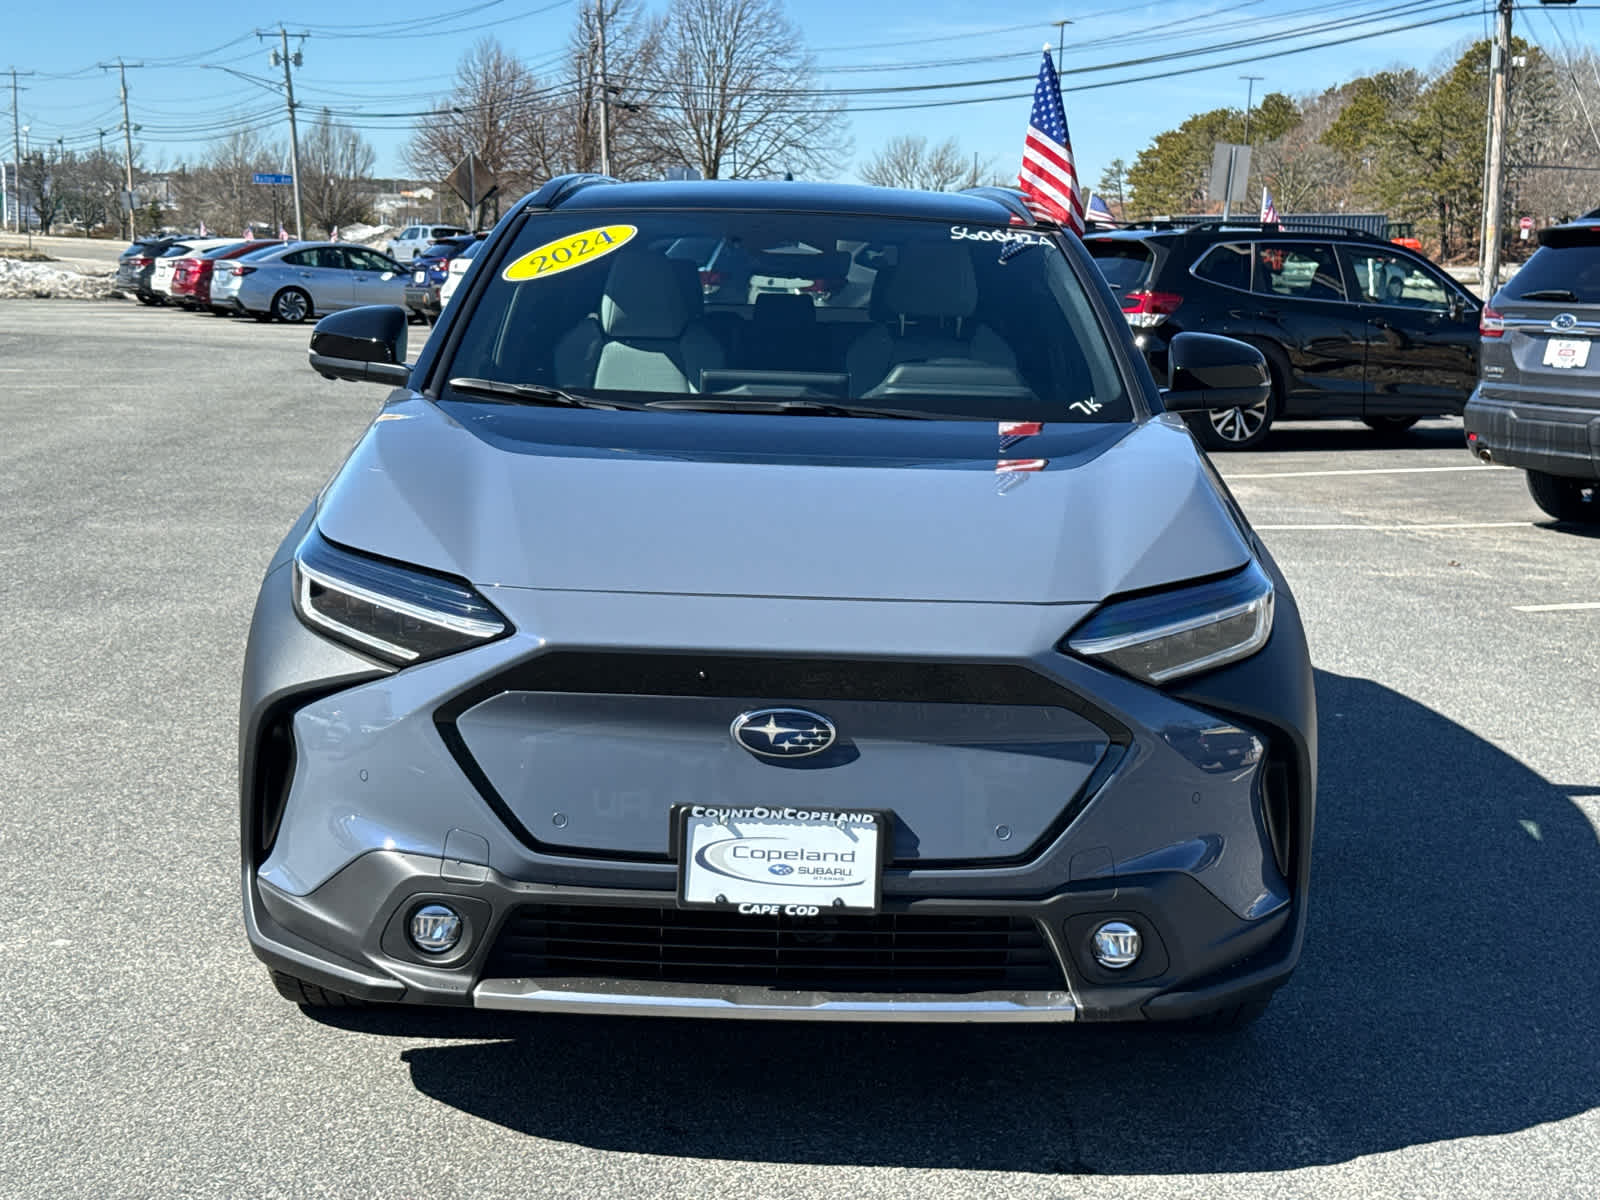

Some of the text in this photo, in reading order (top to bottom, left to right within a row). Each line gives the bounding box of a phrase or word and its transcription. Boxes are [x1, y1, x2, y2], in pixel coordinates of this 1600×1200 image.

[530, 231, 616, 273] 2024
[732, 845, 857, 863] Copeland
[797, 866, 853, 877] SUBARU
[738, 902, 819, 916] CAPE COD
